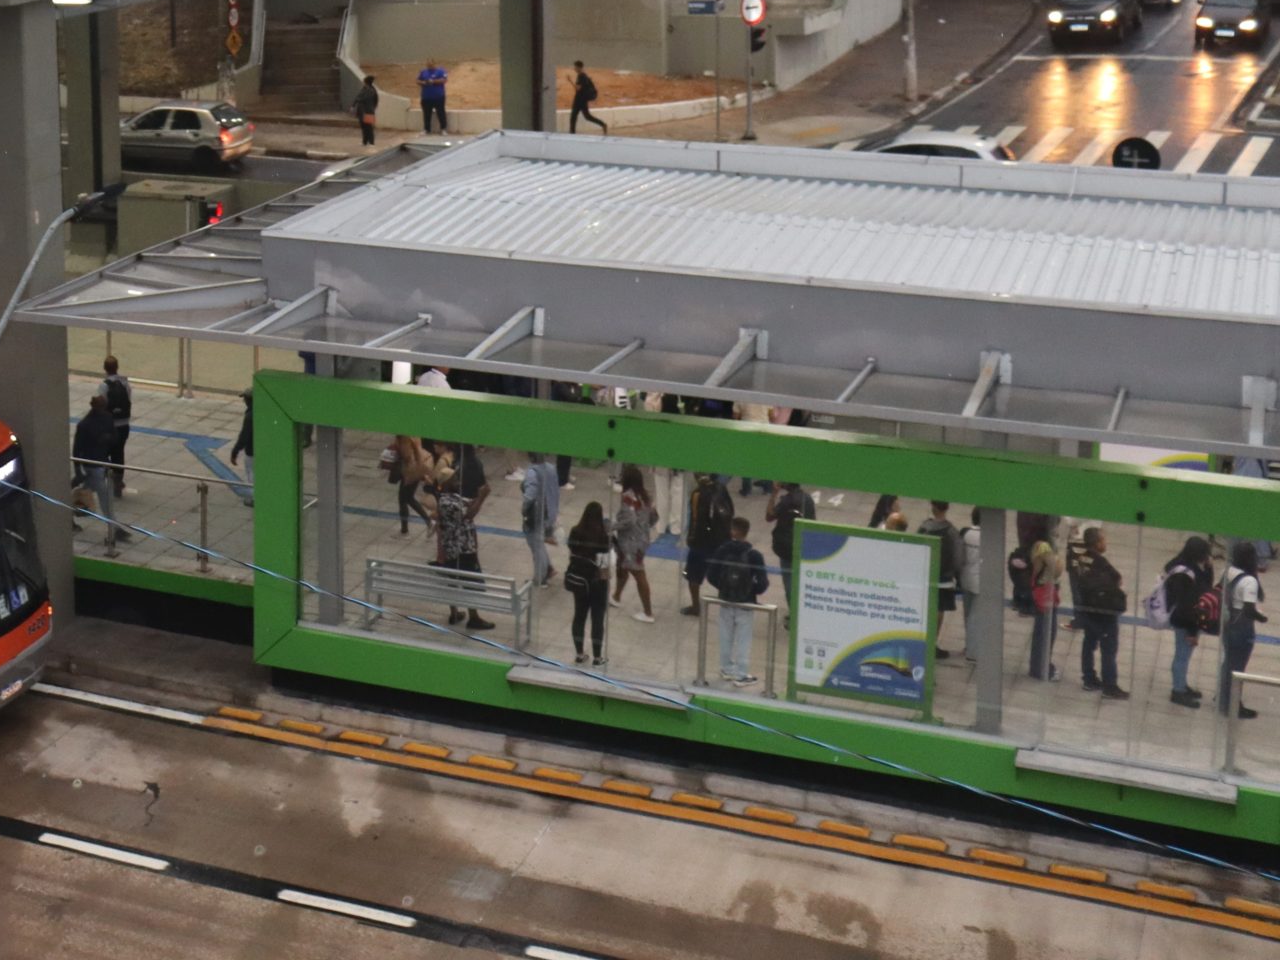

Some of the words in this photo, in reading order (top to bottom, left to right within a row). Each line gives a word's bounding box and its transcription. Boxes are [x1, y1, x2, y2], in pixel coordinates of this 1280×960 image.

[805, 569, 814, 578] O
[815, 570, 836, 580] BRT
[846, 576, 870, 586] para
[804, 583, 825, 593] Mais
[827, 586, 858, 598] ônibus
[804, 593, 834, 603] Menos
[835, 597, 866, 608] tempo
[804, 601, 825, 611] Mais
[826, 605, 868, 617] tranquilo
